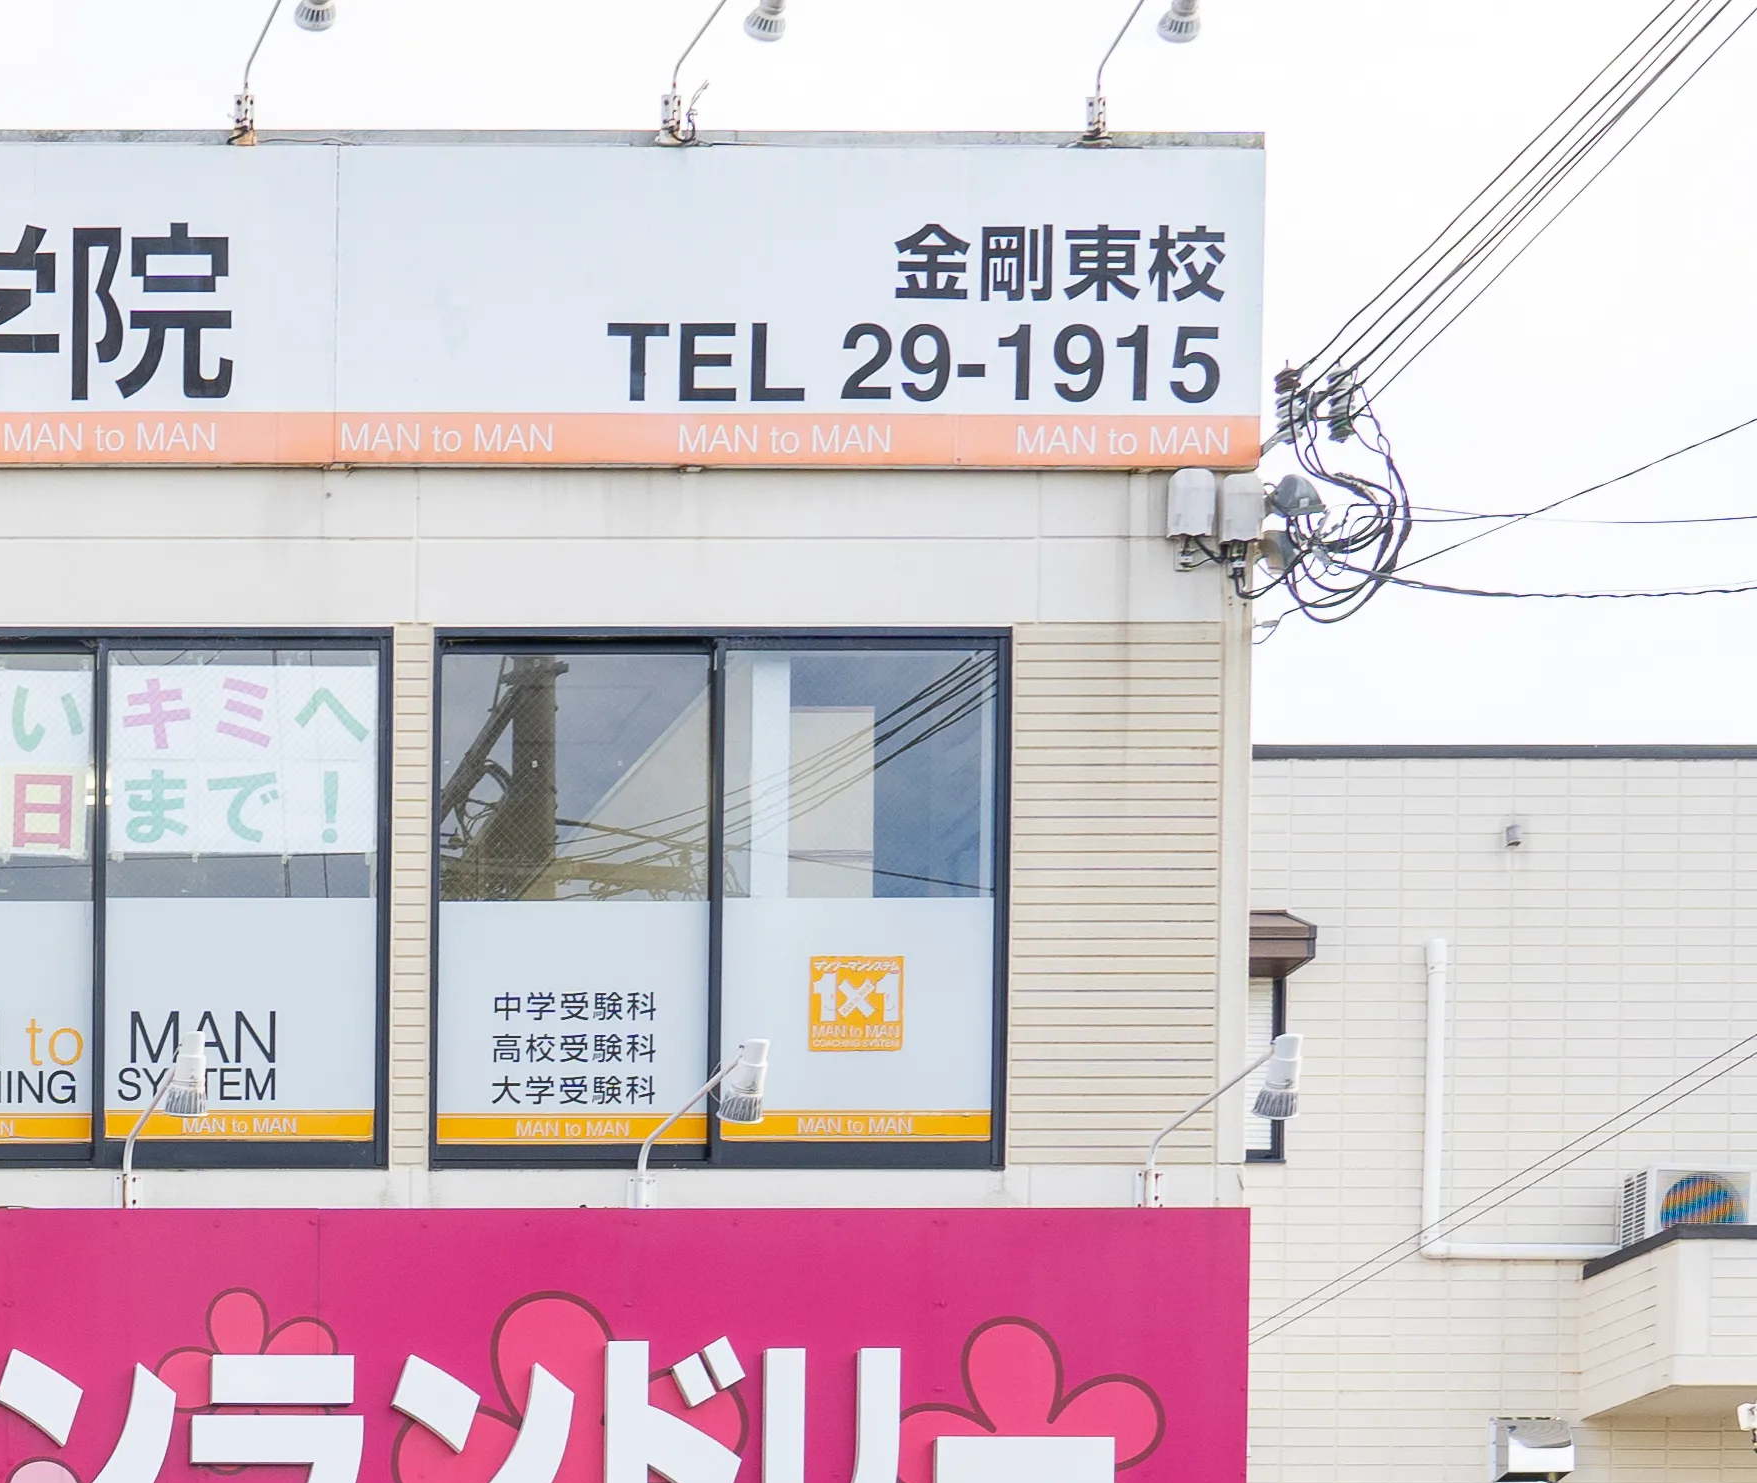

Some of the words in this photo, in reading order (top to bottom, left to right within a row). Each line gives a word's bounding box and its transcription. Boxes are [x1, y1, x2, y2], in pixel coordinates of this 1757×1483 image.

[895, 224, 1225, 302] 金剛東校
[607, 323, 805, 401] TEL
[841, 323, 1220, 403] 29-1915
[5, 423, 82, 451] MAN
[95, 424, 124, 451] to
[137, 422, 215, 451] MAN
[342, 423, 419, 450] MAN
[432, 425, 462, 451] to
[475, 424, 552, 451] MAN
[679, 425, 757, 452] MAN
[770, 427, 800, 453] to
[812, 425, 890, 452] MAN
[1017, 426, 1096, 454] MAN
[1108, 428, 1138, 454] to
[1151, 426, 1228, 454] MAN
[493, 992, 656, 1021] 中学受験科
[26, 1017, 84, 1066] to
[129, 1010, 275, 1063] MAN
[813, 1025, 845, 1037] MAN
[849, 1025, 862, 1037] to
[866, 1025, 899, 1037] MAN
[492, 1034, 656, 1063] 高校受験科
[118, 1066, 275, 1101] SYTEM
[491, 1075, 656, 1104] 大学受験科
[516, 1120, 559, 1137] MAN
[565, 1120, 580, 1137] to
[586, 1120, 629, 1137] MAN
